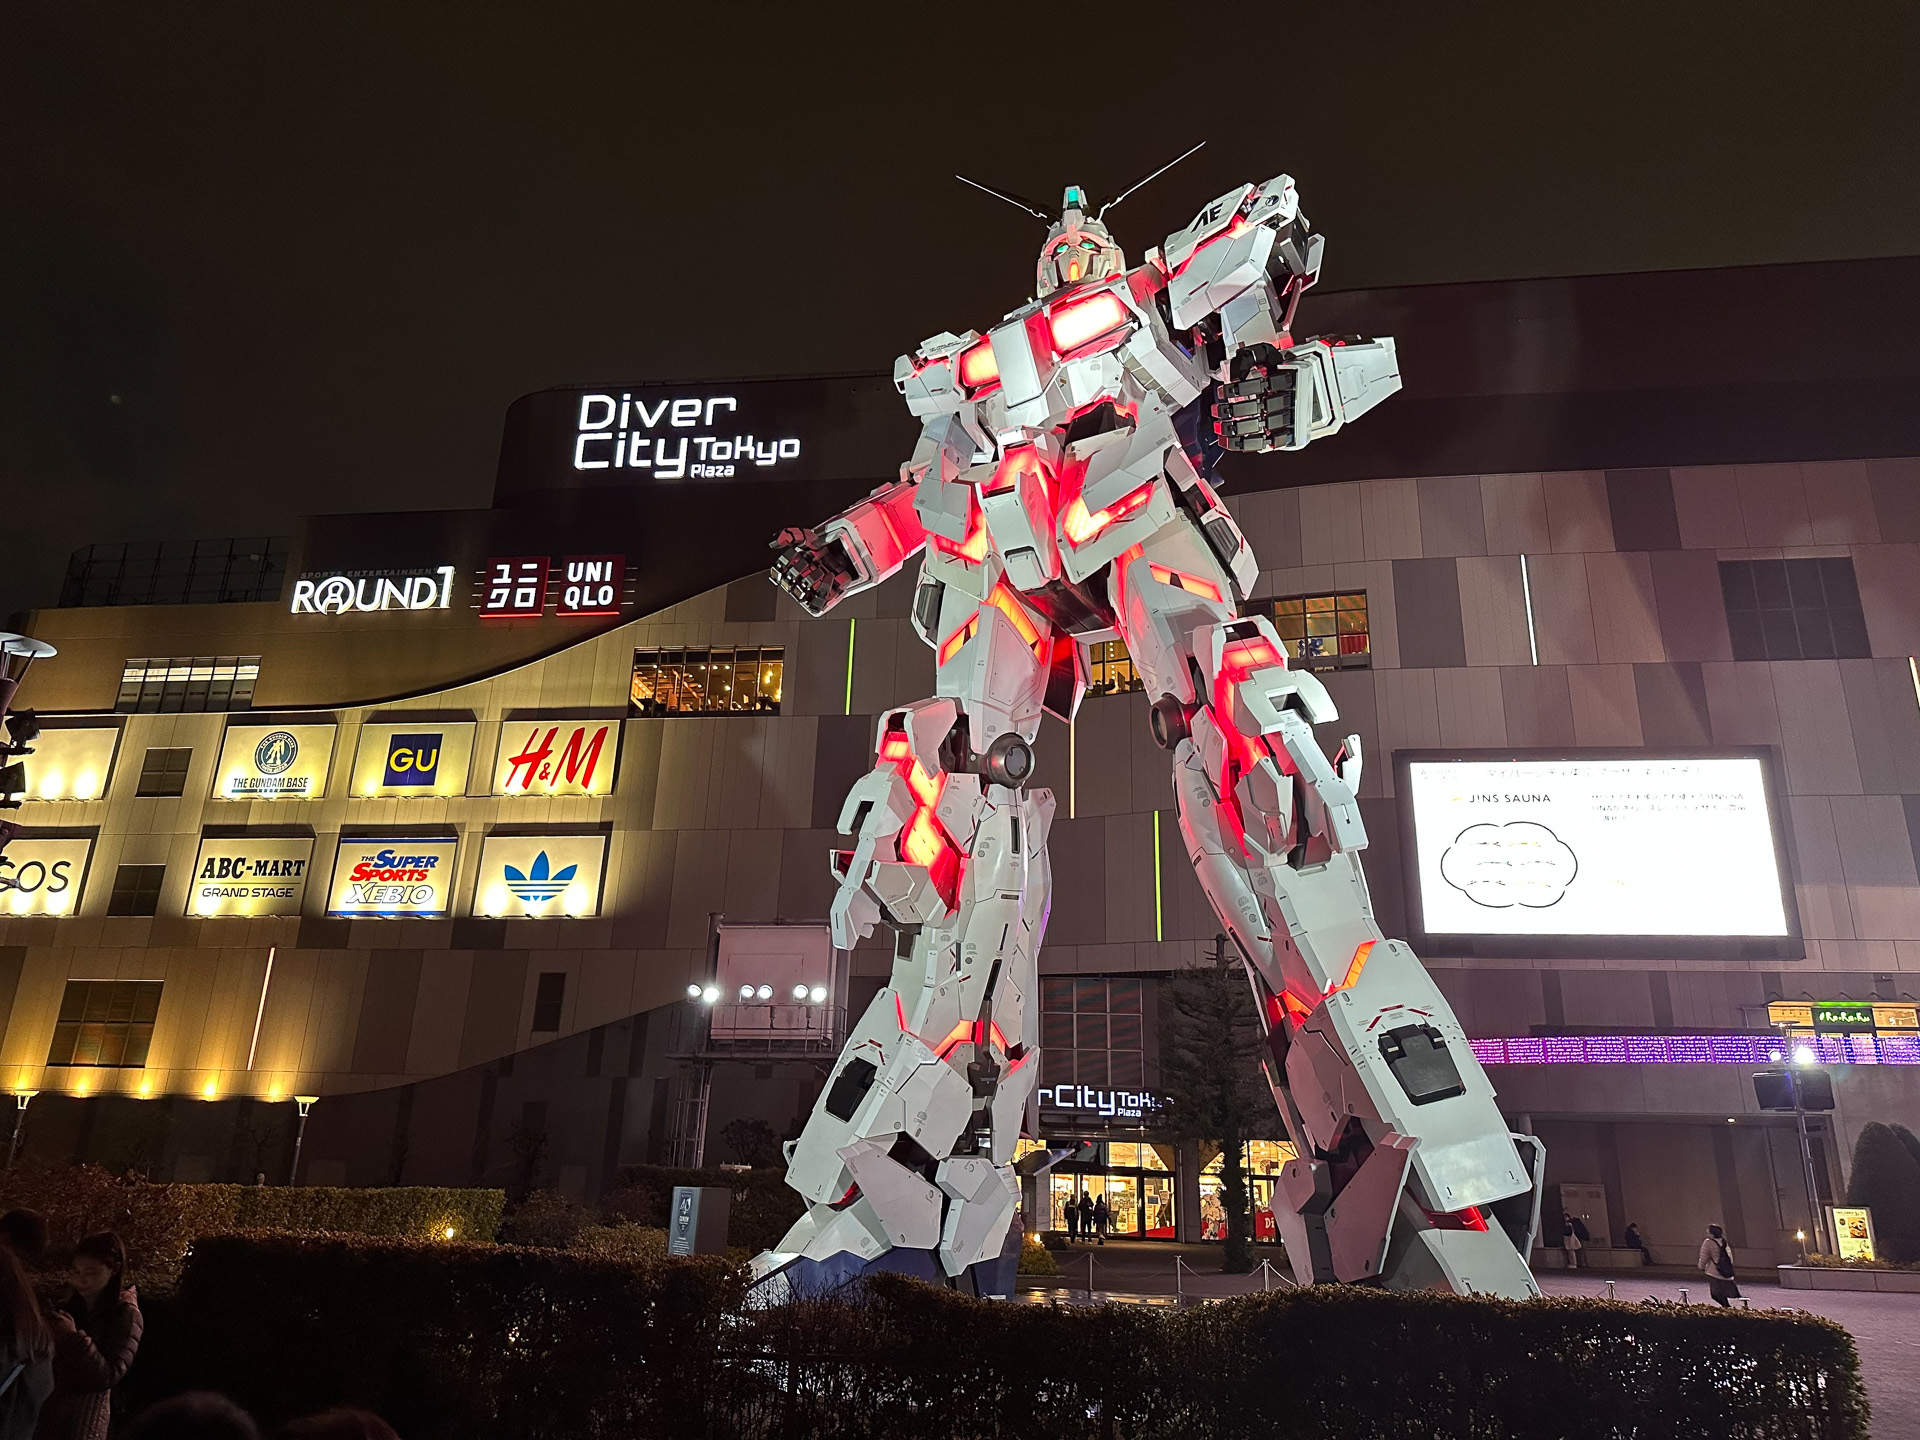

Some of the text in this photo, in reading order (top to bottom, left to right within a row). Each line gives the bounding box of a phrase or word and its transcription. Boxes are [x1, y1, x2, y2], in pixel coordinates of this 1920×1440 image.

[578, 393, 737, 431] Diver
[574, 431, 801, 479] City Tokyo
[690, 464, 736, 479] Plaza
[491, 563, 539, 584] ユニ
[567, 561, 613, 583] UNI
[564, 585, 614, 610] QLO
[389, 747, 438, 773] GU
[504, 726, 609, 790] H&M
[233, 777, 309, 788] THE GUNDAM BASE
[1505, 794, 1551, 803] SAUNA
[199, 857, 306, 879] ABC-MART
[372, 849, 440, 869] SUPER
[348, 862, 430, 882] SPORTS
[202, 887, 295, 898] GRAND STAGE
[345, 882, 434, 905] XEBIO
[1037, 1084, 1116, 1116] rCity
[1117, 1107, 1142, 1117] Plaza
